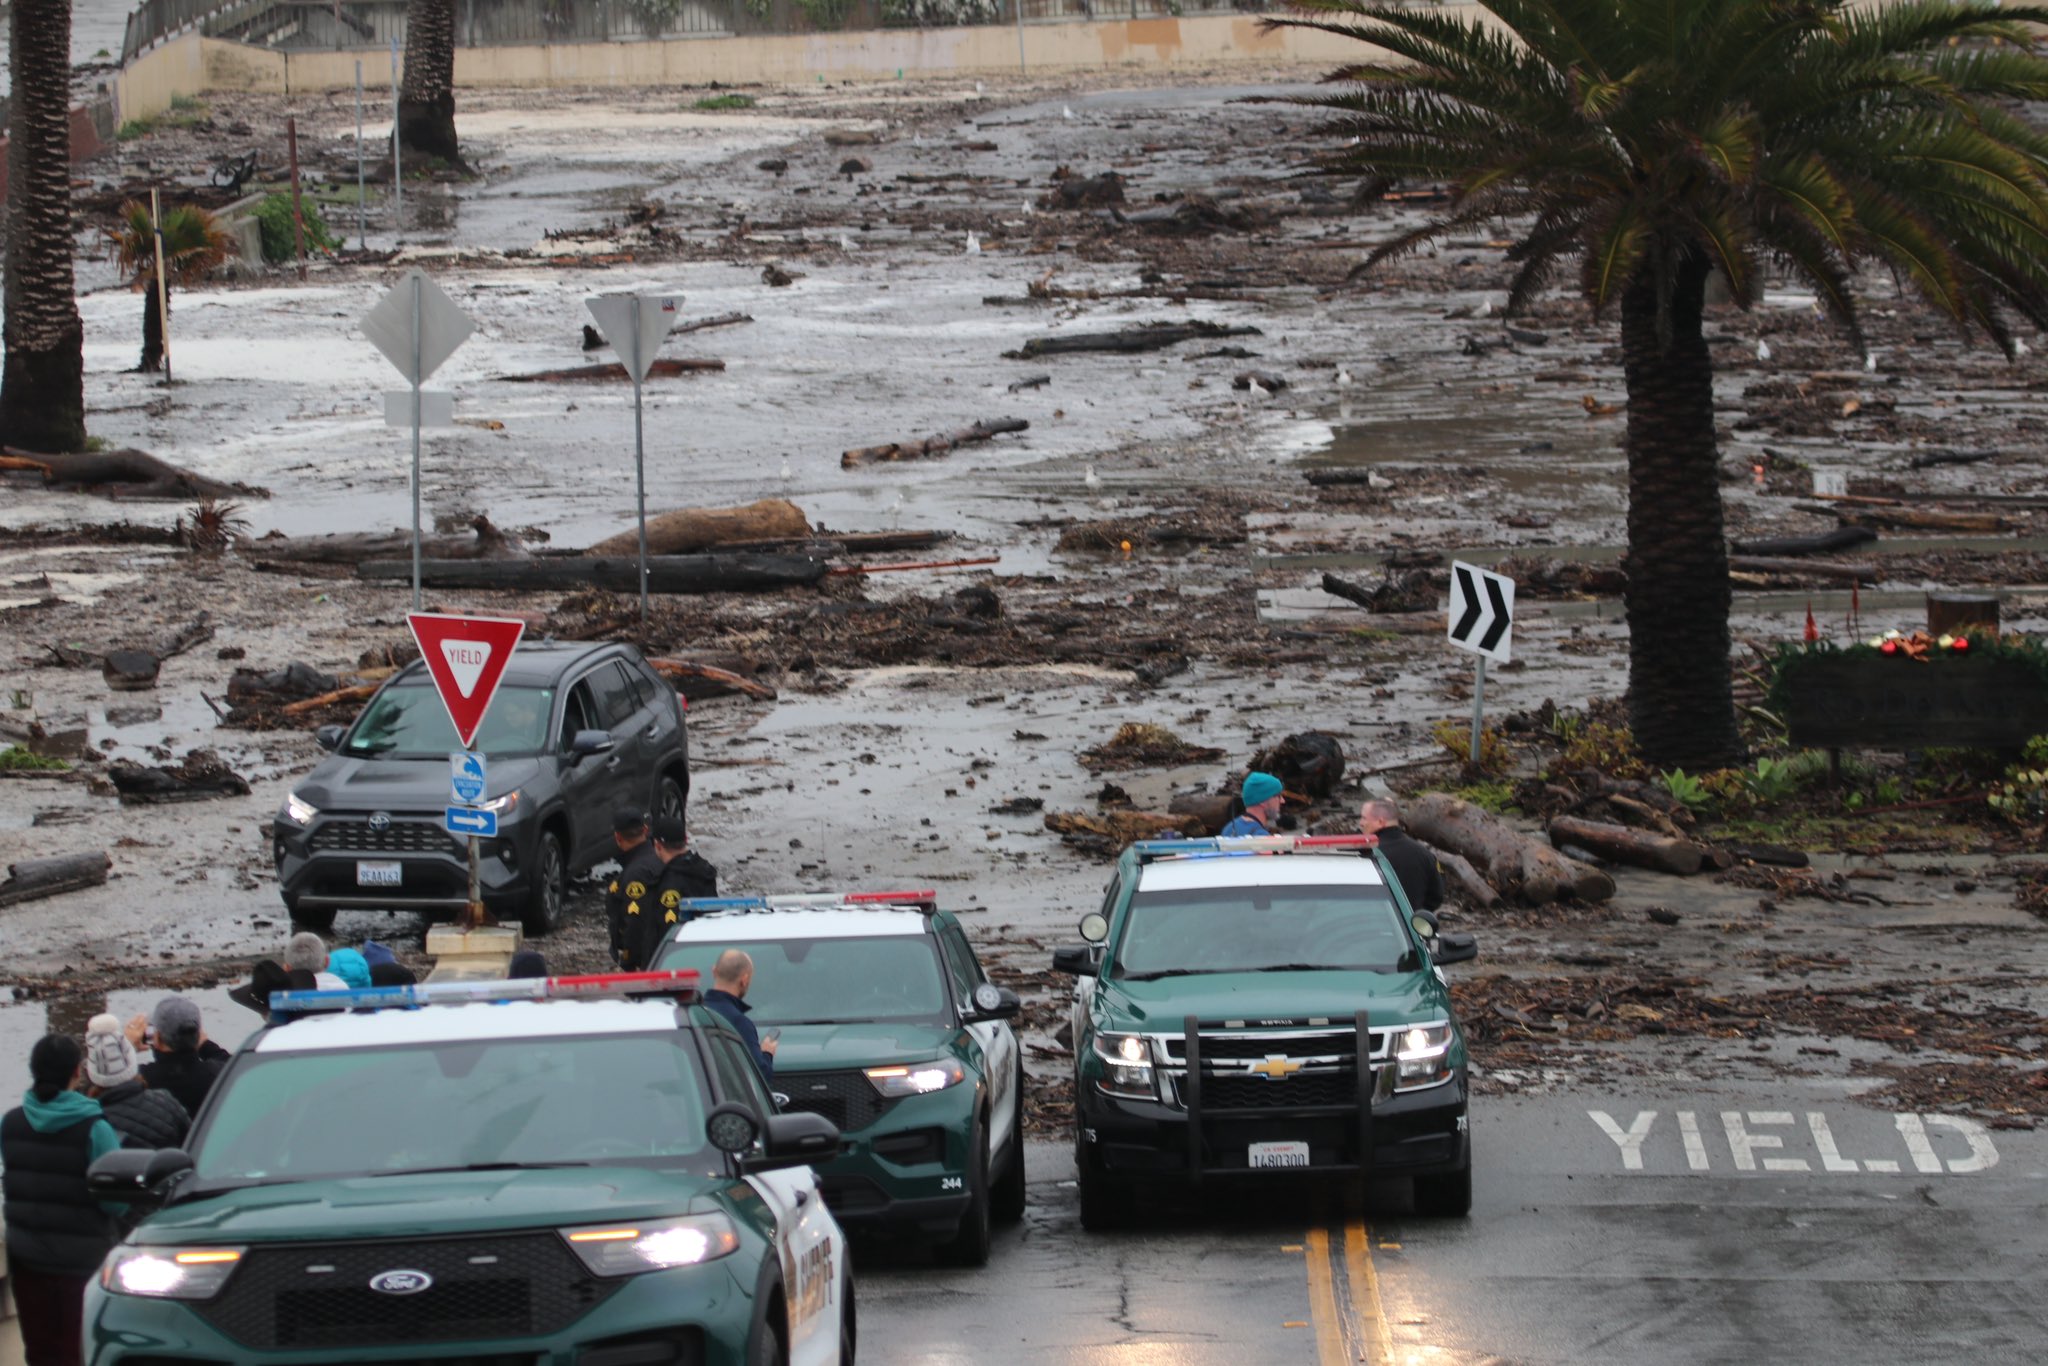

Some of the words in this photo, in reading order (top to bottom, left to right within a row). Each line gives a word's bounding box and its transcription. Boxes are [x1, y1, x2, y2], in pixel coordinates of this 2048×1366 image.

[449, 648, 481, 665] YIELD
[1587, 1111, 2000, 1173] YIELD
[1254, 1153, 1305, 1168] 1480300
[942, 1177, 962, 1190] 244
[384, 1275, 416, 1290] Ford
